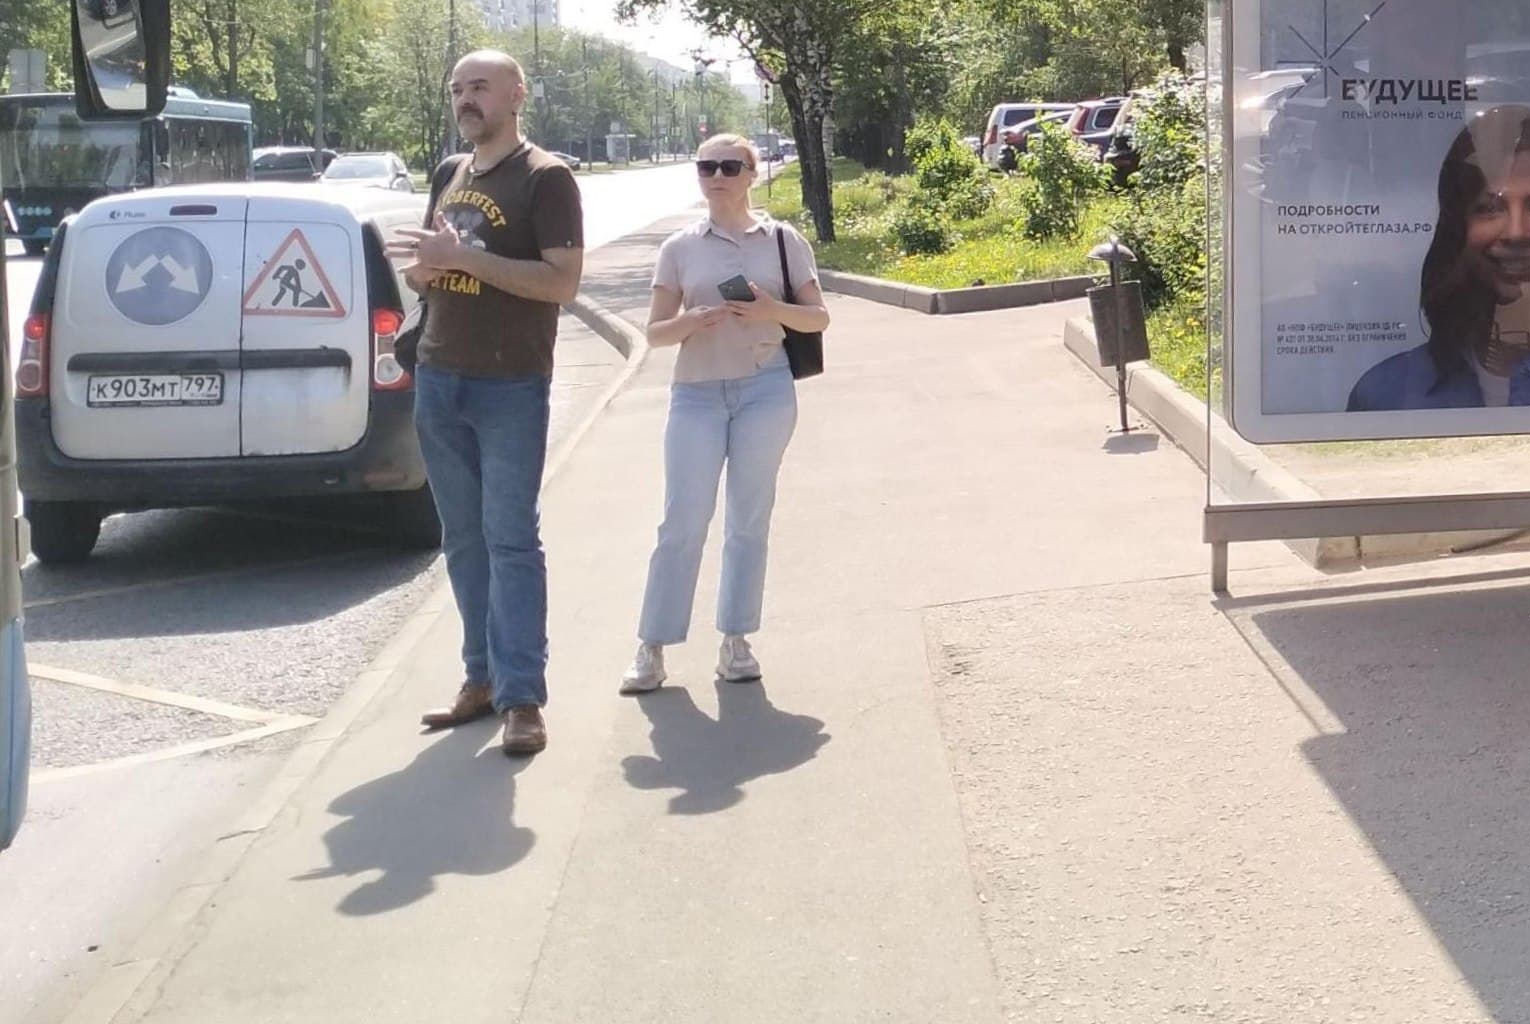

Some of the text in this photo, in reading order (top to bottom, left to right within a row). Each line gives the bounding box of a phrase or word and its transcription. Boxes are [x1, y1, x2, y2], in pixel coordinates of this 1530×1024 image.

[1427, 110, 1464, 121] ФОНД
[1277, 205, 1381, 218] ПОДРОБНОСТИ
[1277, 221, 1433, 235] НА ОТКРОЙТЕГЛАЗА.РФ
[442, 273, 481, 296] TEAM
[182, 377, 217, 392] 797
